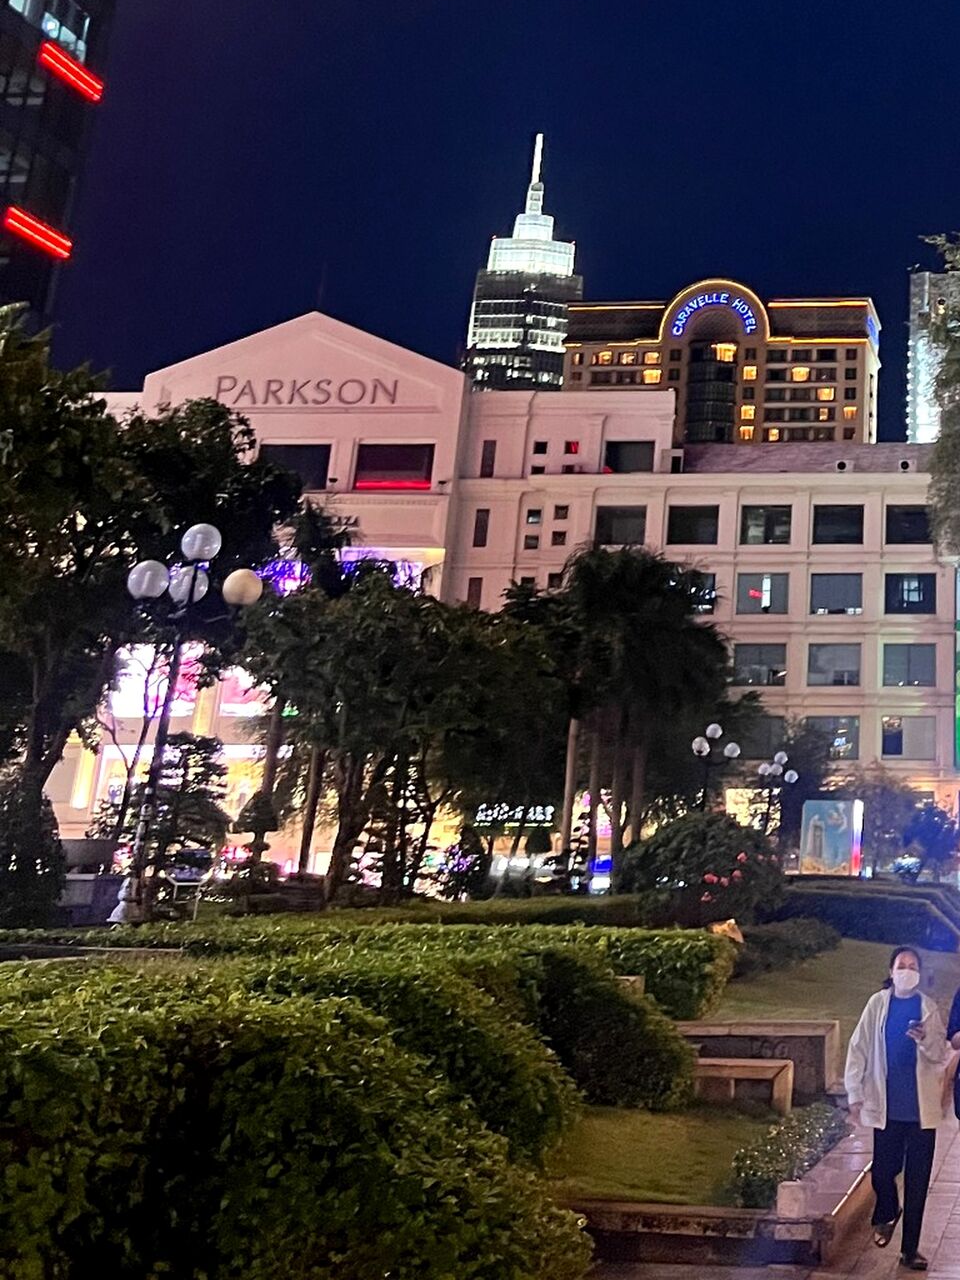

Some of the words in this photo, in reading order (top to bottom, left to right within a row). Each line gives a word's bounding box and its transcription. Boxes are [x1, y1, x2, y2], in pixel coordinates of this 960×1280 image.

[672, 293, 730, 336] CARAVELLE
[731, 298, 757, 334] HOTEL
[215, 375, 399, 406] PARKSON
